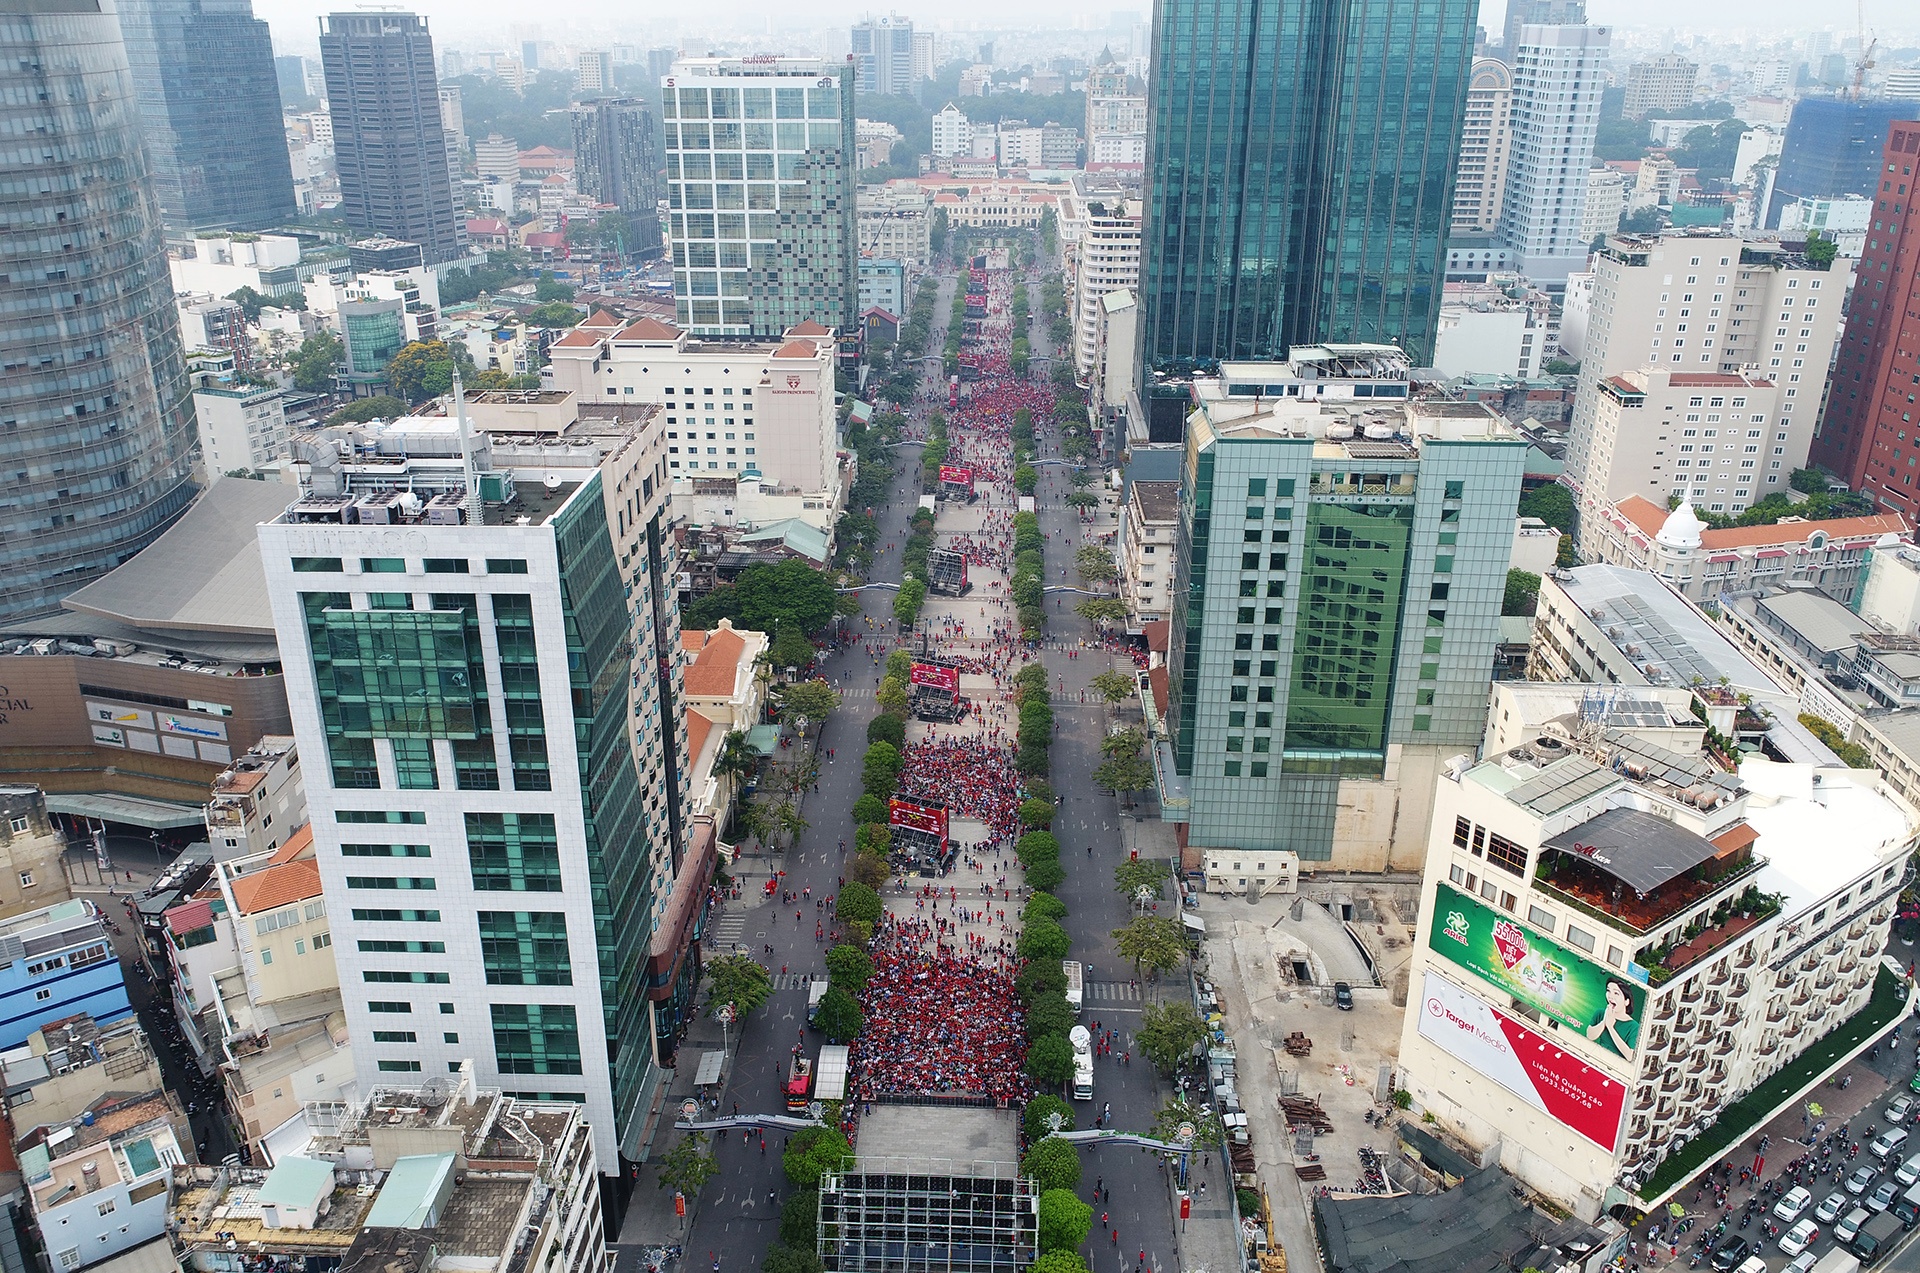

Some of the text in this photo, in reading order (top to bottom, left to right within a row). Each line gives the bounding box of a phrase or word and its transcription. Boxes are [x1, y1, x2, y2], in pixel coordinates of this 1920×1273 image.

[742, 56, 776, 65] SUNWAH
[817, 77, 832, 88] citi
[99, 709, 113, 720] EY
[1442, 927, 1469, 947] ARIEL
[1445, 1008, 1507, 1053] Target Media
[1532, 1060, 1549, 1074] Liên
[1561, 1078, 1587, 1098] Quảng
[1588, 1095, 1603, 1107] cáo
[1539, 1073, 1592, 1109] 0933.39.67.68
